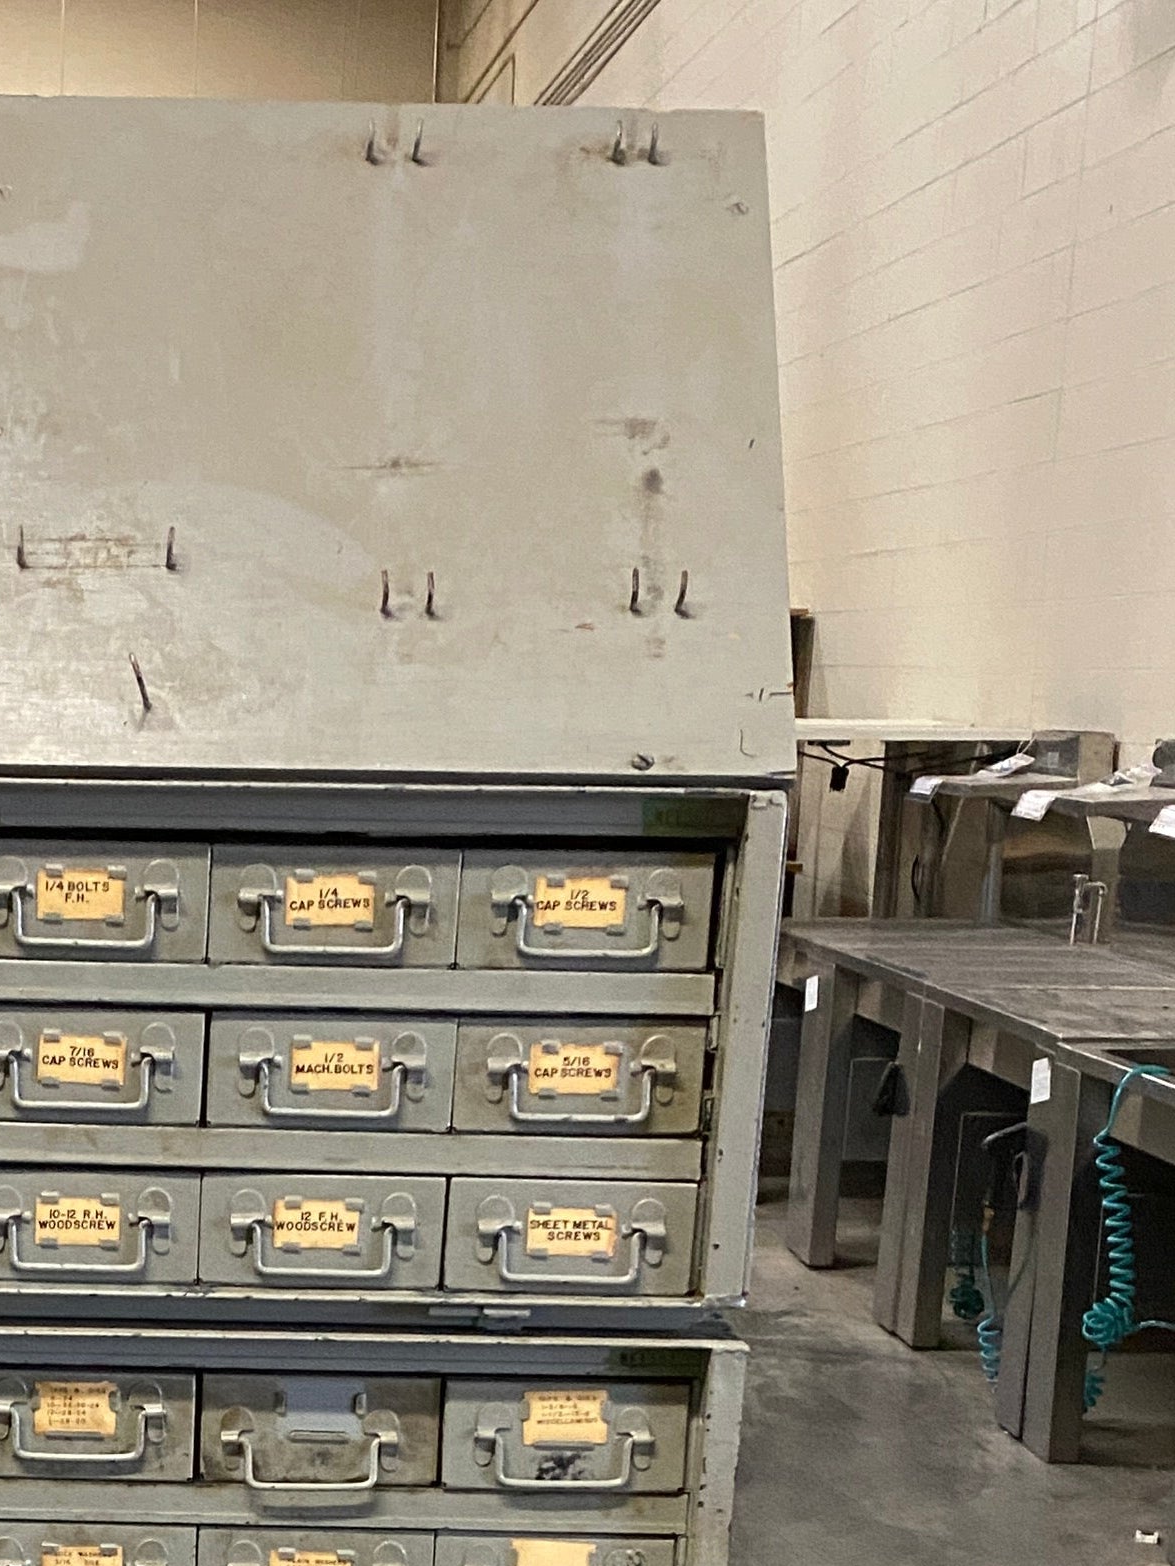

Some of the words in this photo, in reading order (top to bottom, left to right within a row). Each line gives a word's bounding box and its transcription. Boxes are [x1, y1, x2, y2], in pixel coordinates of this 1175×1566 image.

[45, 881, 64, 891] 1/4
[67, 881, 110, 892] BOLTS
[319, 887, 338, 898] 1/4
[570, 889, 589, 900] 1/2
[64, 893, 90, 904] F.H.
[289, 900, 316, 911] CAP
[318, 898, 370, 909] SCREWS
[536, 900, 560, 910] CAP
[564, 900, 617, 911] SCREWS
[69, 1046, 94, 1057] 7/16
[42, 1055, 65, 1065] CAP
[69, 1057, 119, 1069] SCREWS
[324, 1053, 344, 1063] 1/2
[563, 1057, 590, 1066] 5/16
[534, 1068, 558, 1077] CAP
[561, 1068, 611, 1078] SCREWS
[49, 1209, 75, 1219] 10-12
[83, 1209, 107, 1219] R.H.
[301, 1212, 312, 1221] 12
[319, 1212, 341, 1221] F.H.
[39, 1220, 116, 1229] WOODSCREW
[276, 1222, 355, 1232] WOODSCREW
[530, 1220, 569, 1230] SHEET
[574, 1220, 612, 1230] METAL
[548, 1231, 601, 1241] SCREWS
